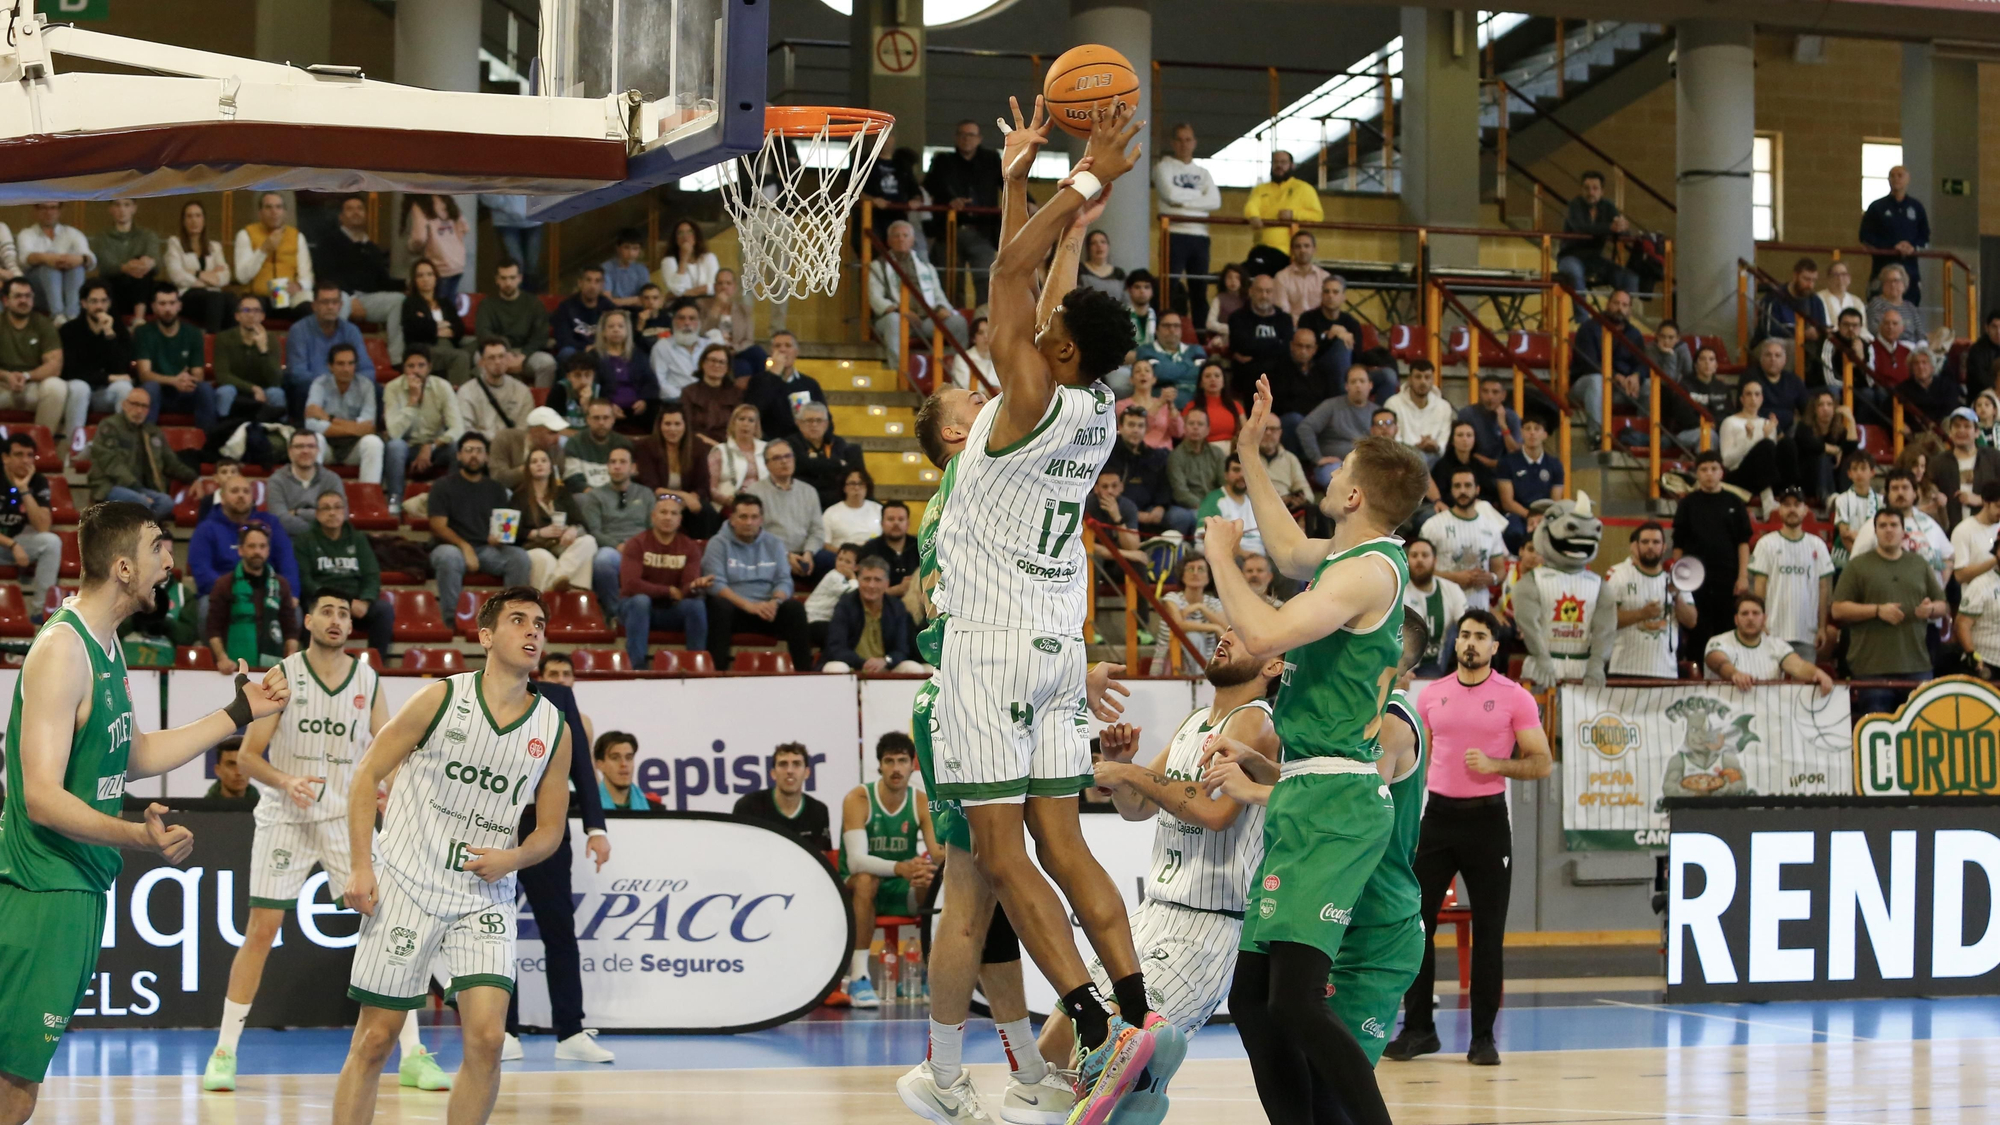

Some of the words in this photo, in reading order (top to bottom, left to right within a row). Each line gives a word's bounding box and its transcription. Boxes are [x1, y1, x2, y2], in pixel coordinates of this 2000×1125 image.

[1037, 498, 1080, 559] 17
[1039, 638, 1058, 653] Ford
[1665, 696, 1731, 723] FRENTE
[429, 798, 467, 822] Fundación
[475, 813, 515, 837] Cajasol
[1157, 848, 1182, 885] 27
[610, 878, 689, 893] GRUPO
[1667, 828, 2000, 985] REND
[602, 953, 634, 973] de
[640, 953, 745, 978] Seguros
